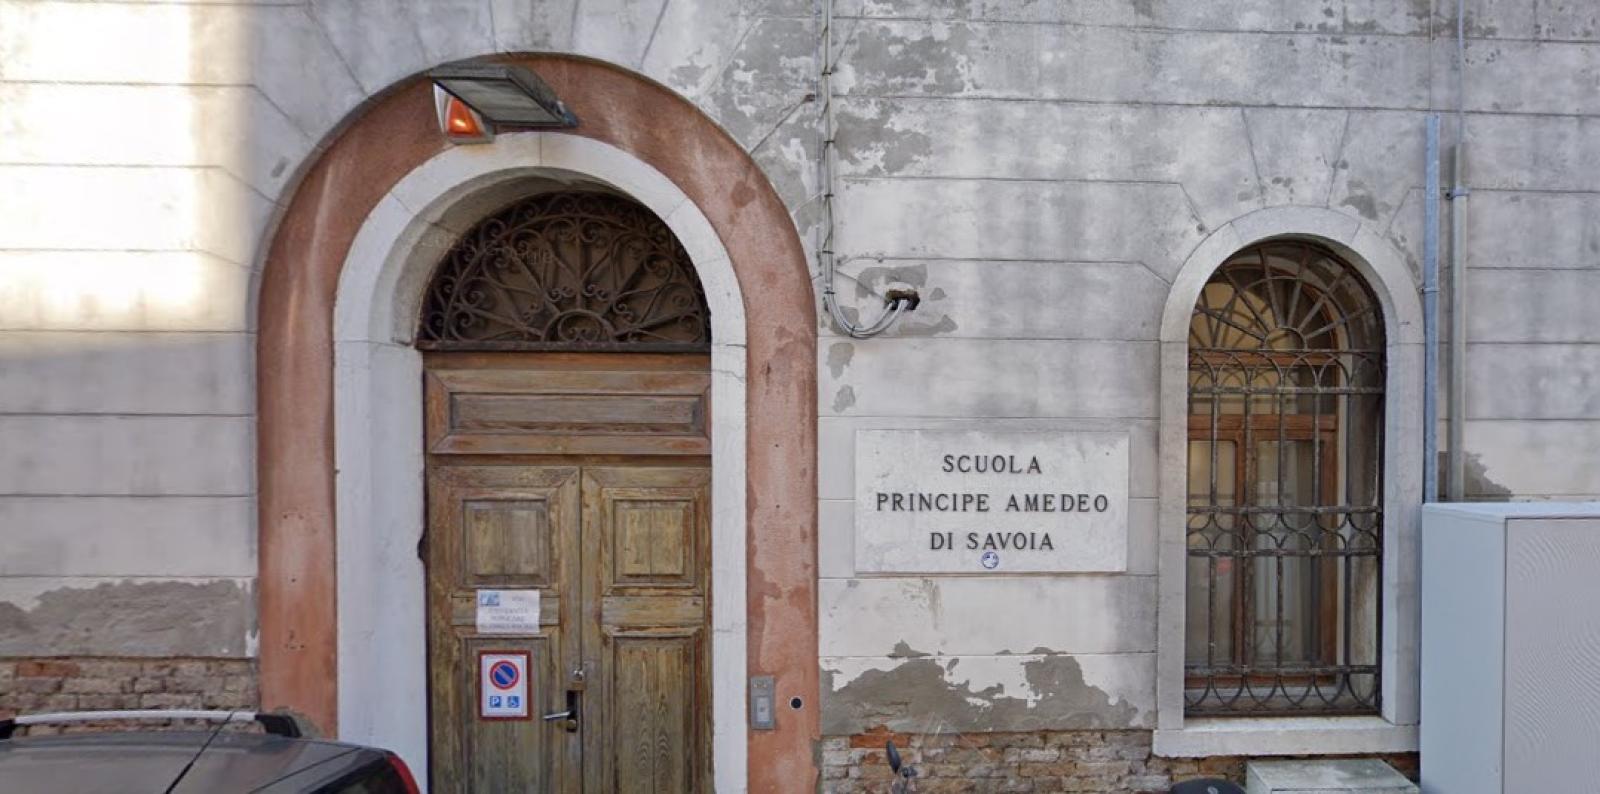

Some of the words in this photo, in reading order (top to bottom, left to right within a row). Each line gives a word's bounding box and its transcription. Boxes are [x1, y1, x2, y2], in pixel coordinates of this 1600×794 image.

[942, 454, 1043, 474] SCUOLA
[876, 492, 990, 512] PRINCIPE
[1005, 493, 1109, 513] AMEDEO
[929, 531, 953, 551] DI
[966, 531, 1055, 551] SAVOIA
